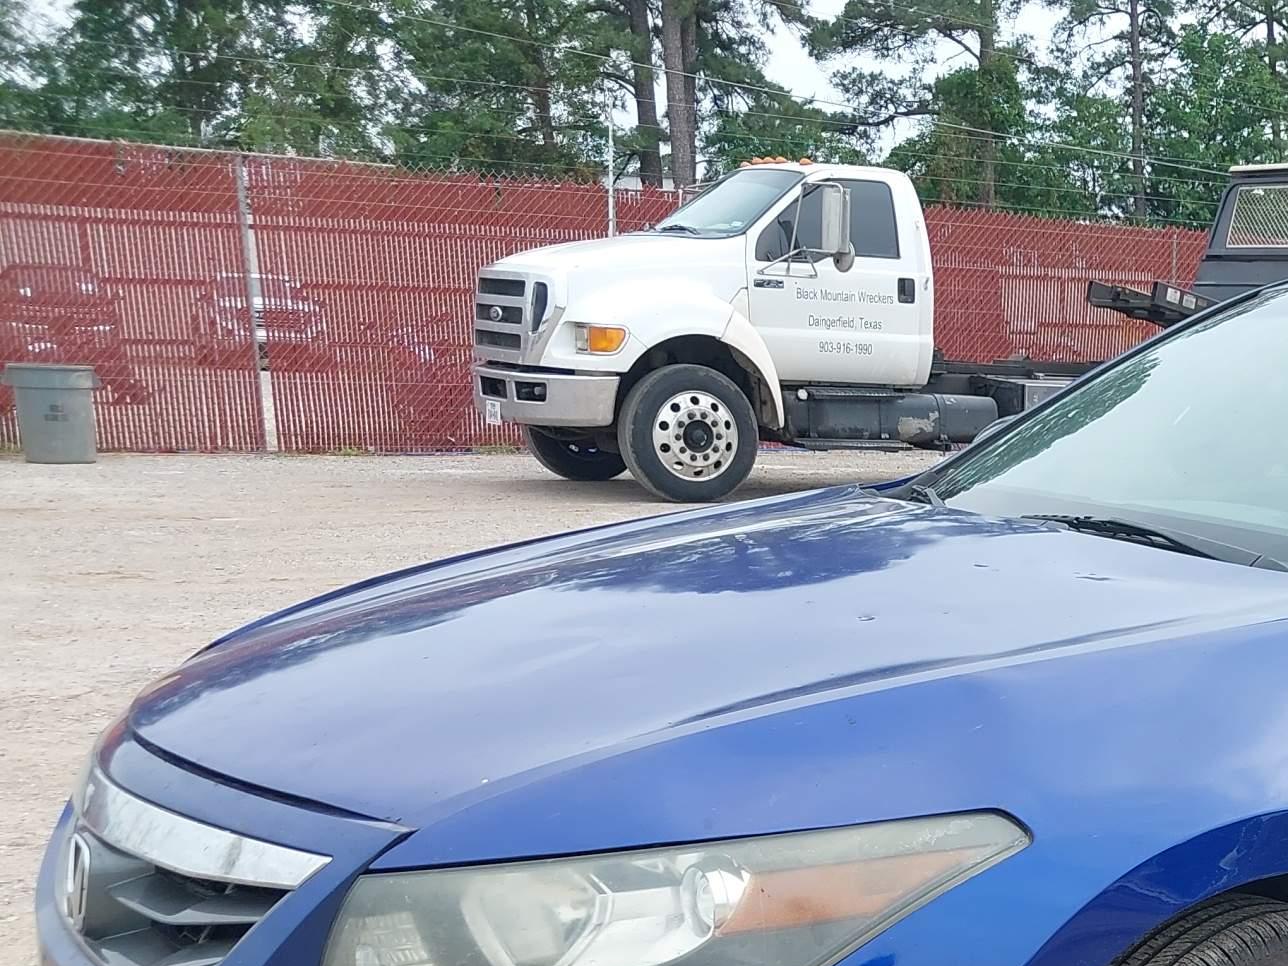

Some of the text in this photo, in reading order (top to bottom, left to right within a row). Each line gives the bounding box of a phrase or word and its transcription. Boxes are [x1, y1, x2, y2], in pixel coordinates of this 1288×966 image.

[796, 287, 894, 305] Black Mountain Wreckers
[808, 314, 882, 330] Daingerfield, Texas
[818, 340, 873, 355] 903-916-1990
